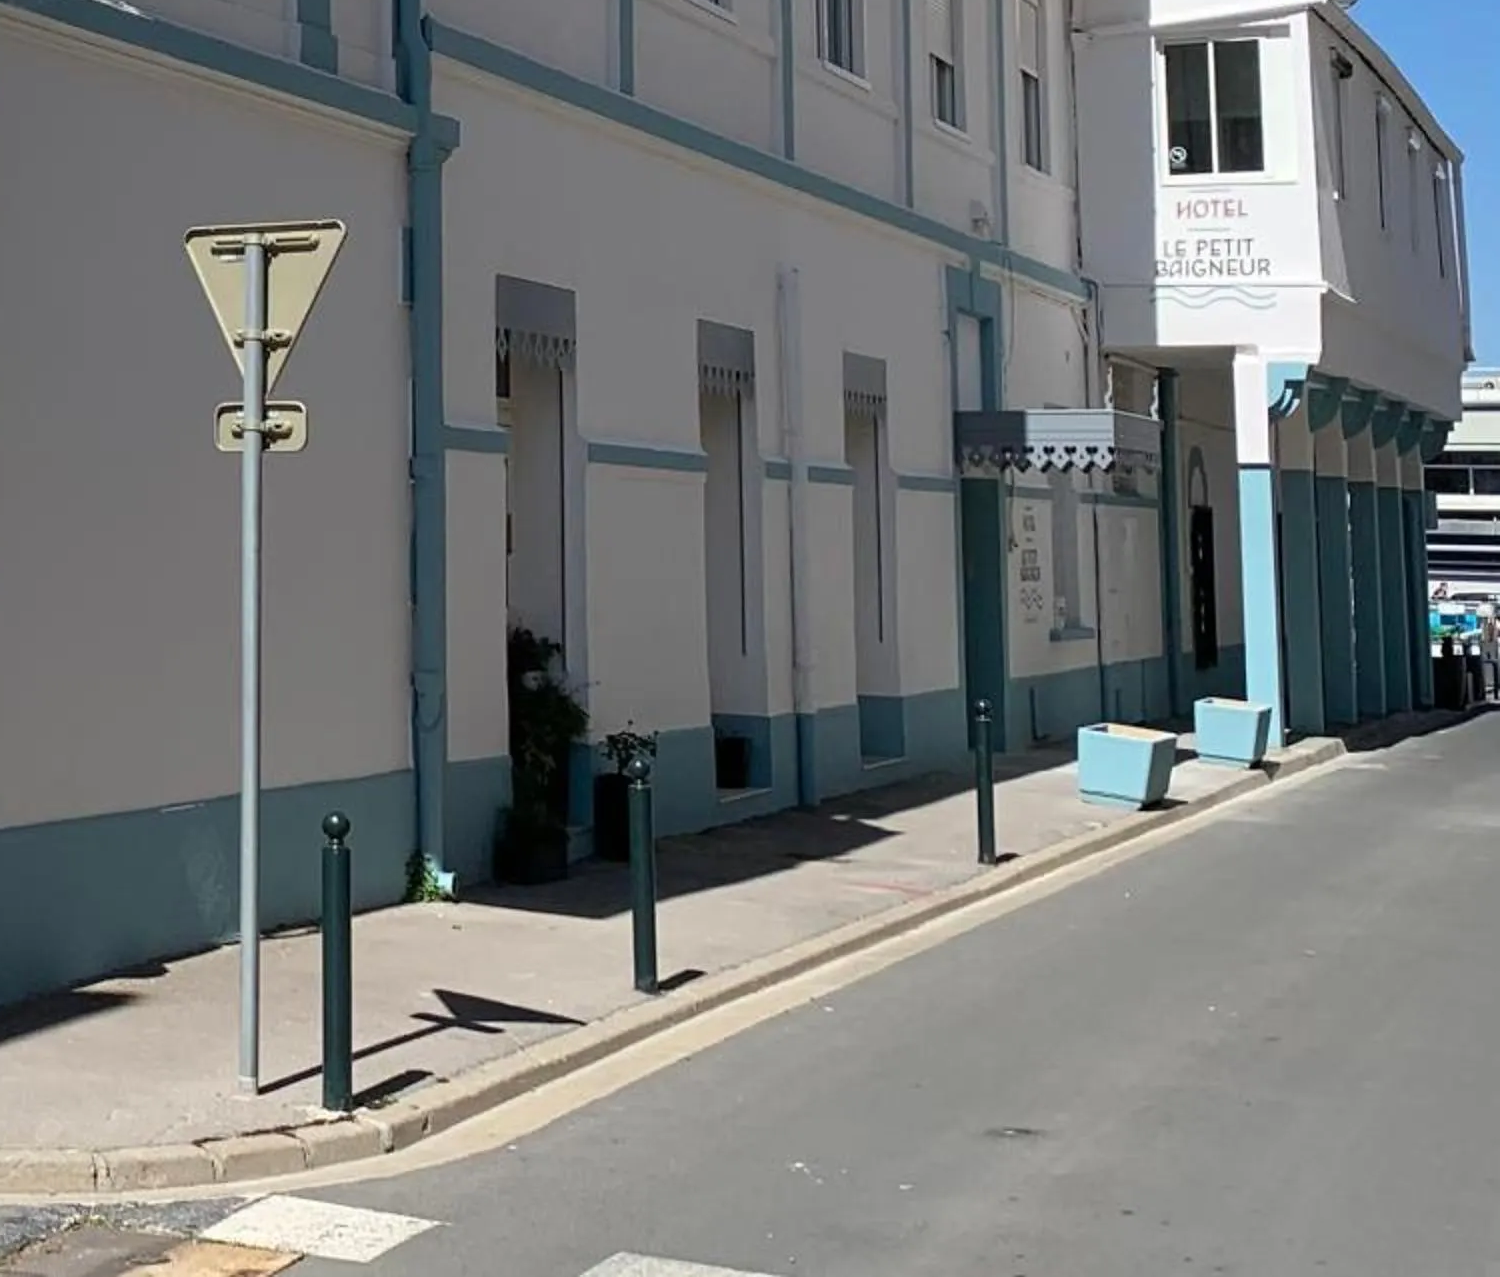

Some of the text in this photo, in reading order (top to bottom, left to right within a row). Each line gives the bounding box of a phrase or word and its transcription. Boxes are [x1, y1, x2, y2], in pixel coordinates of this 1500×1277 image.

[1176, 199, 1249, 219] HOTEL
[1163, 238, 1255, 258] LE PETIT
[1155, 258, 1271, 277] BAIGNEUR
